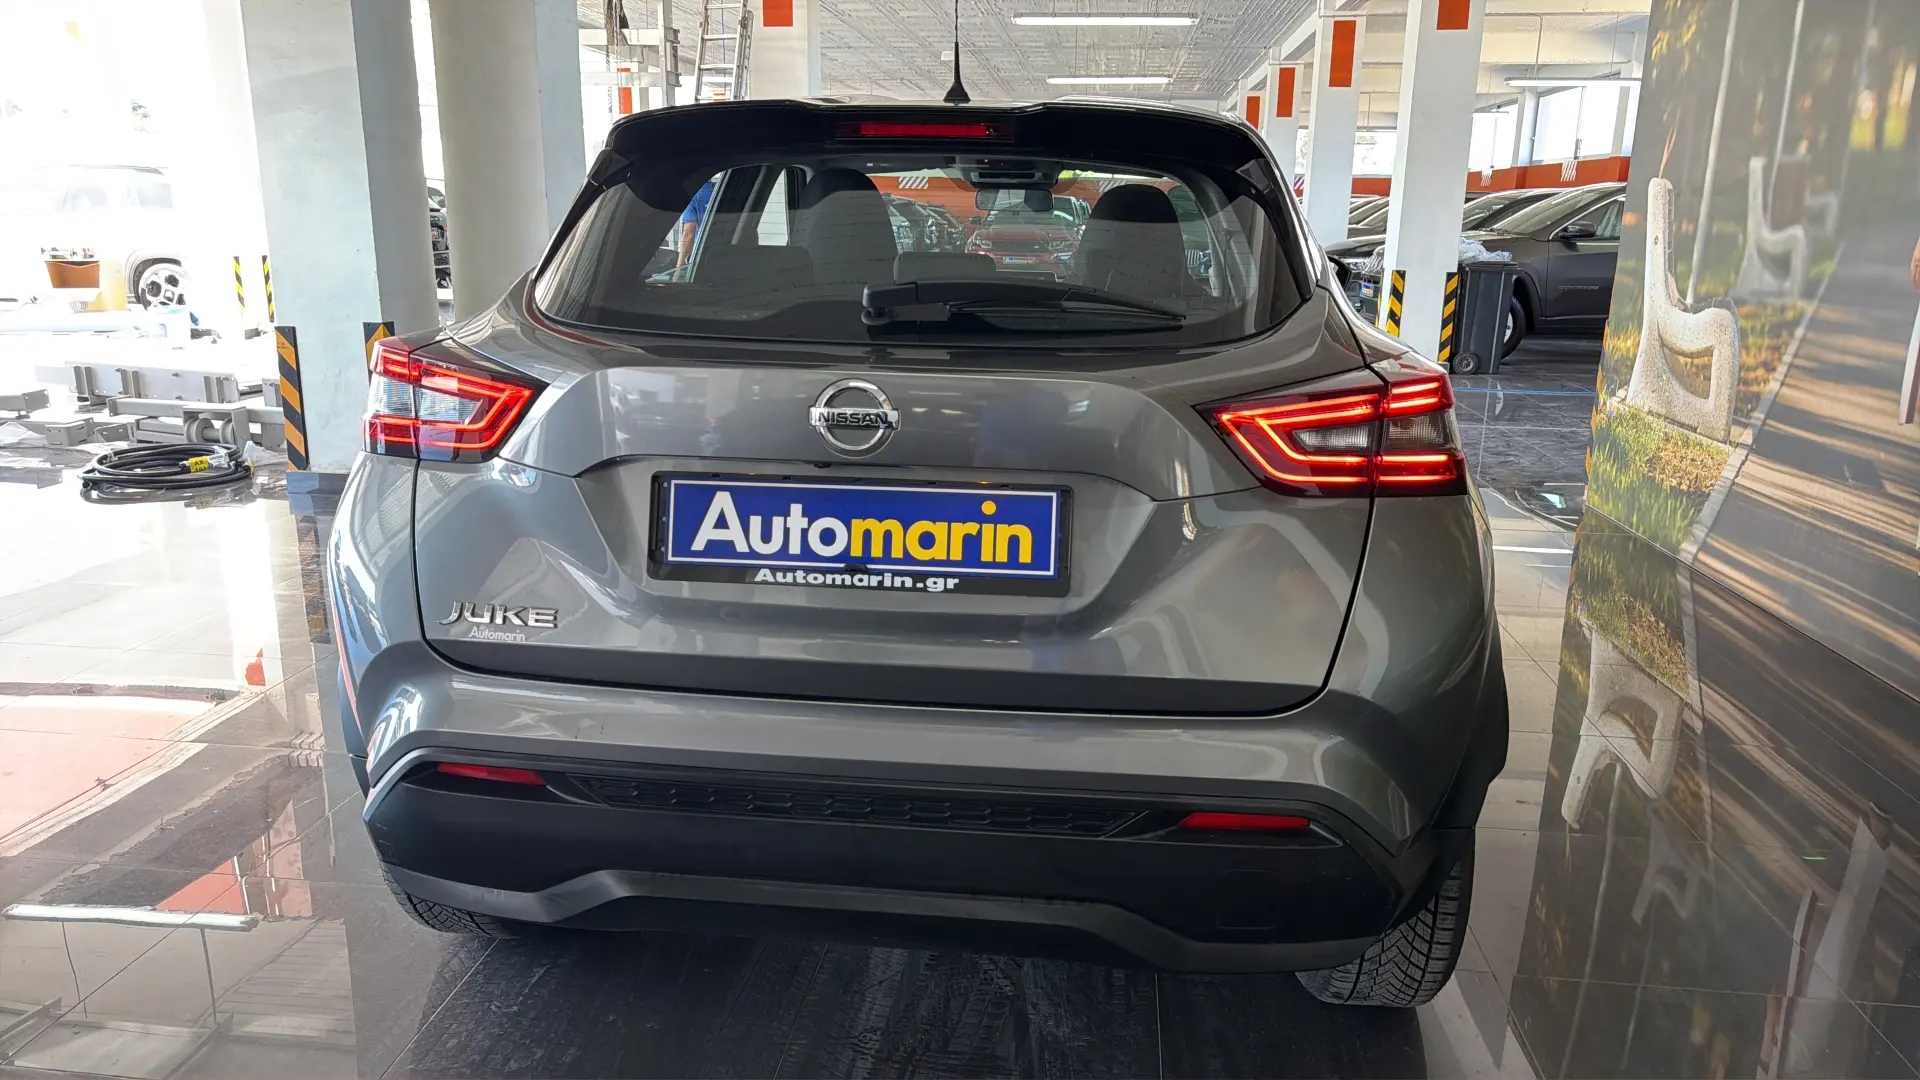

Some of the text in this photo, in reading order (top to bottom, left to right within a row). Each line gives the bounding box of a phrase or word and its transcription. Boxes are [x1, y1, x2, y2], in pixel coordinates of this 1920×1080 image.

[818, 410, 889, 425] NISSAN
[690, 490, 1033, 564] Automarin
[753, 567, 960, 592] Automarin.gr
[436, 600, 559, 629] JUKE
[468, 626, 526, 642] Automarin
